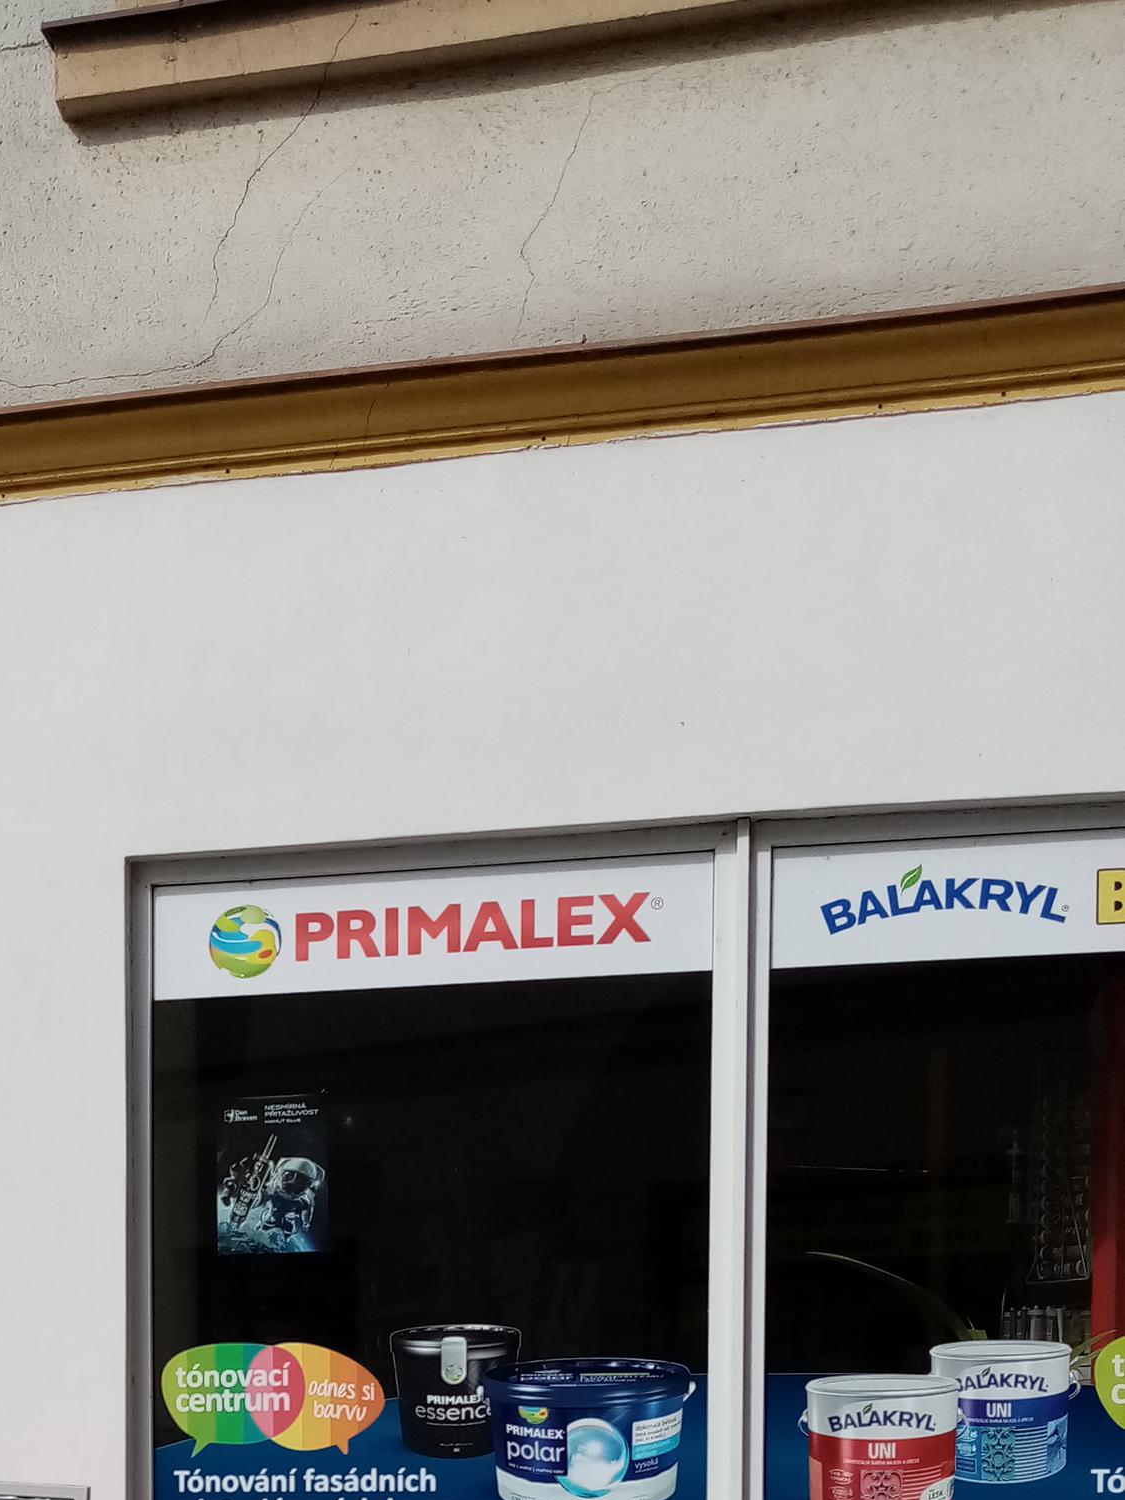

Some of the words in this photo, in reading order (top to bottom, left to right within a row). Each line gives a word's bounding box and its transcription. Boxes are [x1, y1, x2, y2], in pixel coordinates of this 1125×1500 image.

[820, 875, 1067, 935] BALAKRYL
[295, 892, 651, 963] PRIMALEX
[175, 1362, 291, 1389] tónovací
[175, 1388, 291, 1414] centrum
[308, 1379, 356, 1400] odnes
[361, 1380, 376, 1401] si
[313, 1400, 367, 1422] barvu
[828, 1408, 937, 1433] BALAKRYL
[986, 1402, 1012, 1418] UNI
[506, 1423, 564, 1440] PRIMALEX
[506, 1440, 565, 1463] polar
[868, 1442, 896, 1459] UNI
[174, 1468, 297, 1493] Tónování
[303, 1467, 437, 1493] fasádních
